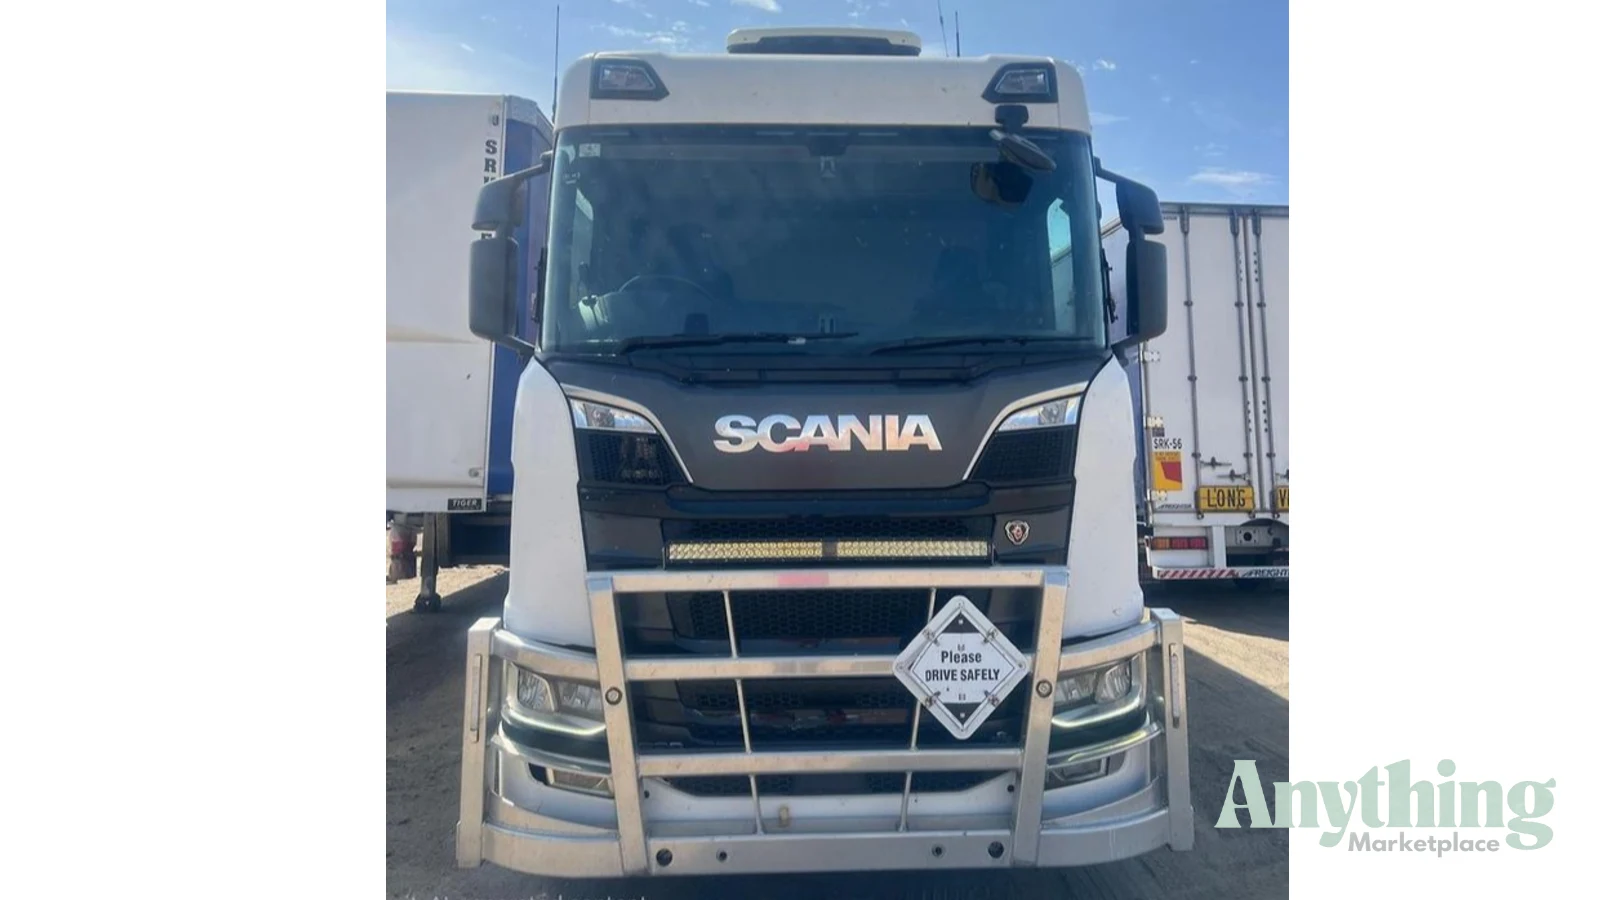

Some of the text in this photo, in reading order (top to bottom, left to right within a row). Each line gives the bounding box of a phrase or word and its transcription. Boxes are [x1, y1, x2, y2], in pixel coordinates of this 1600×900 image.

[713, 414, 943, 453] SCANIA
[1153, 438, 1183, 449] SRK-56
[452, 499, 478, 507] TIGER
[1207, 488, 1289, 507] LONG V
[941, 650, 982, 663] Please
[925, 669, 1000, 681] DRIVE SAFELY
